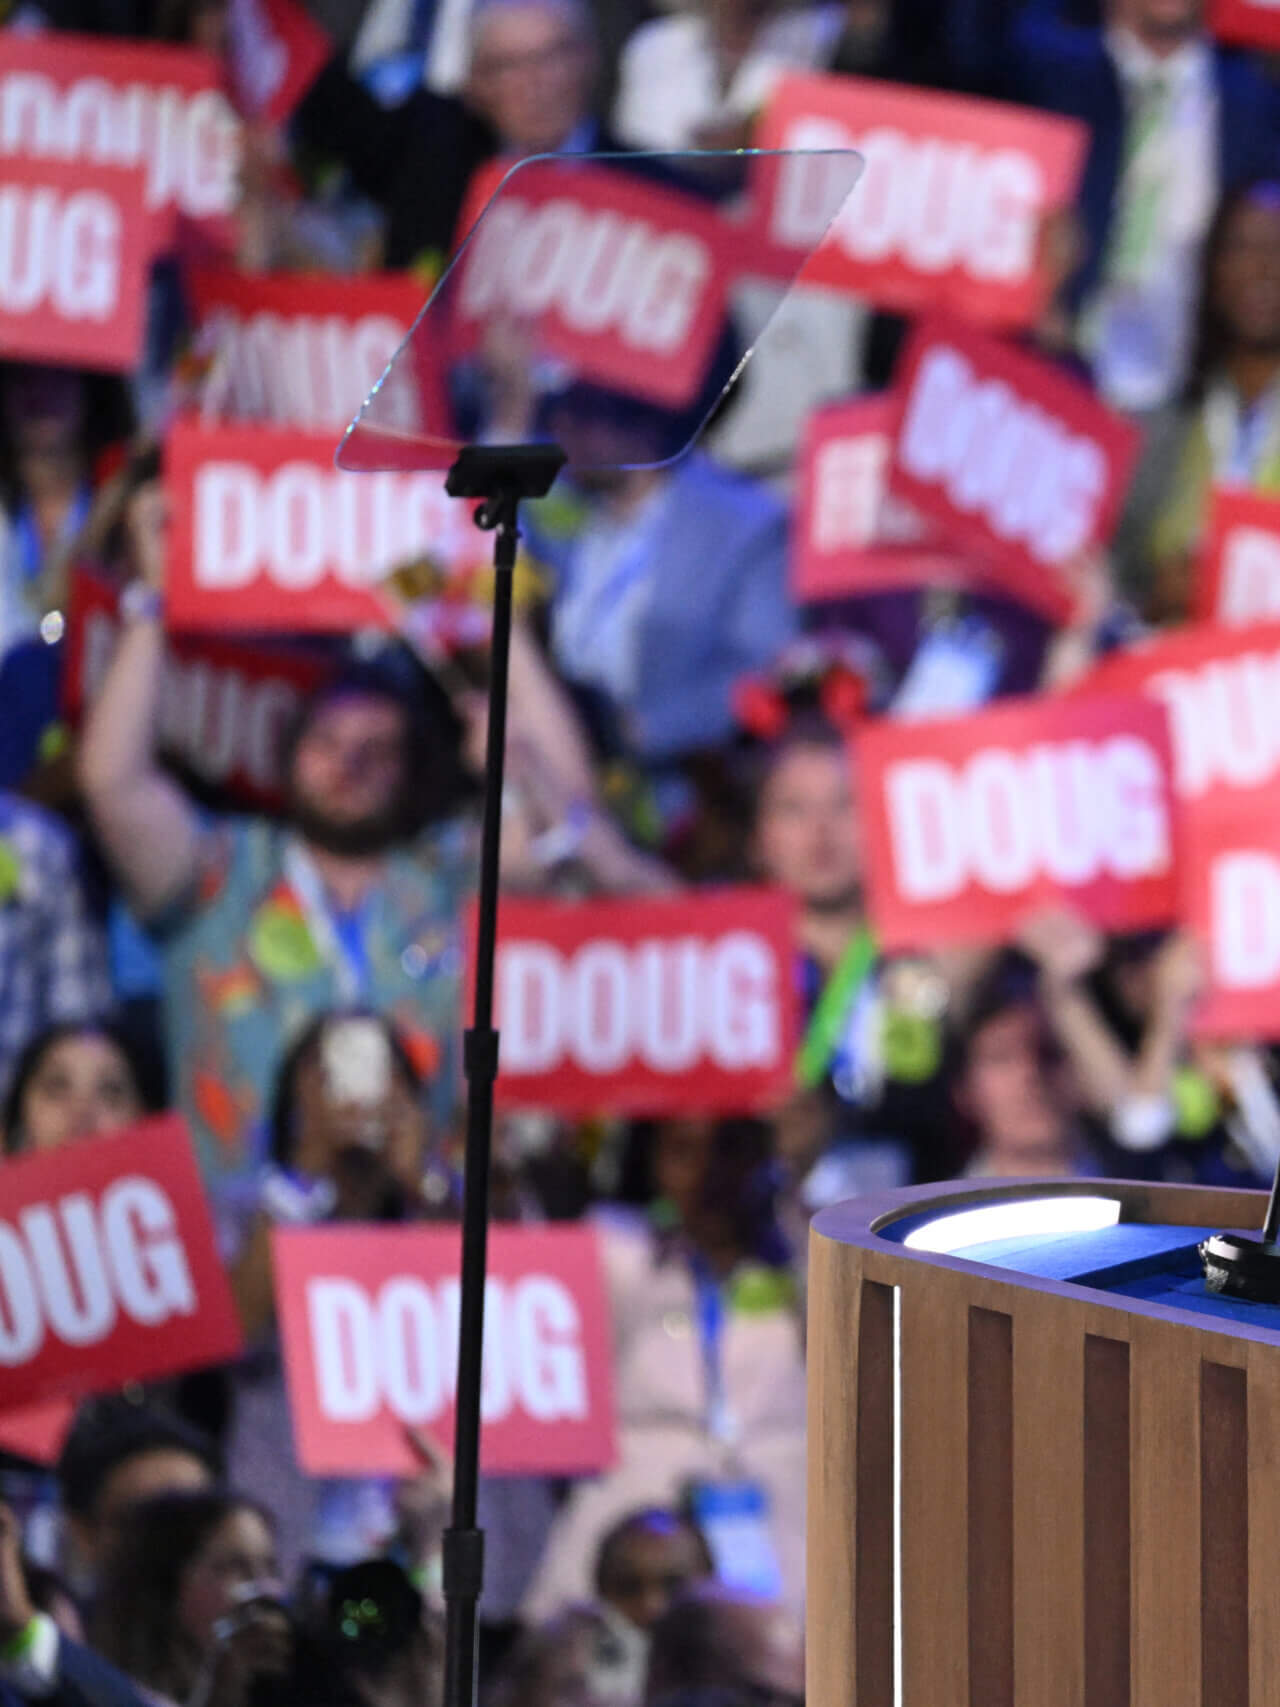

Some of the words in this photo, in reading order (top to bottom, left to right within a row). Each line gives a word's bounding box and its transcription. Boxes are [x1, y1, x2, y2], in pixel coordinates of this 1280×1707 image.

[771, 119, 1042, 282] DOUG
[884, 736, 1170, 901] DOUG
[497, 935, 778, 1074] DOUG
[308, 1275, 591, 1422] DOUG
